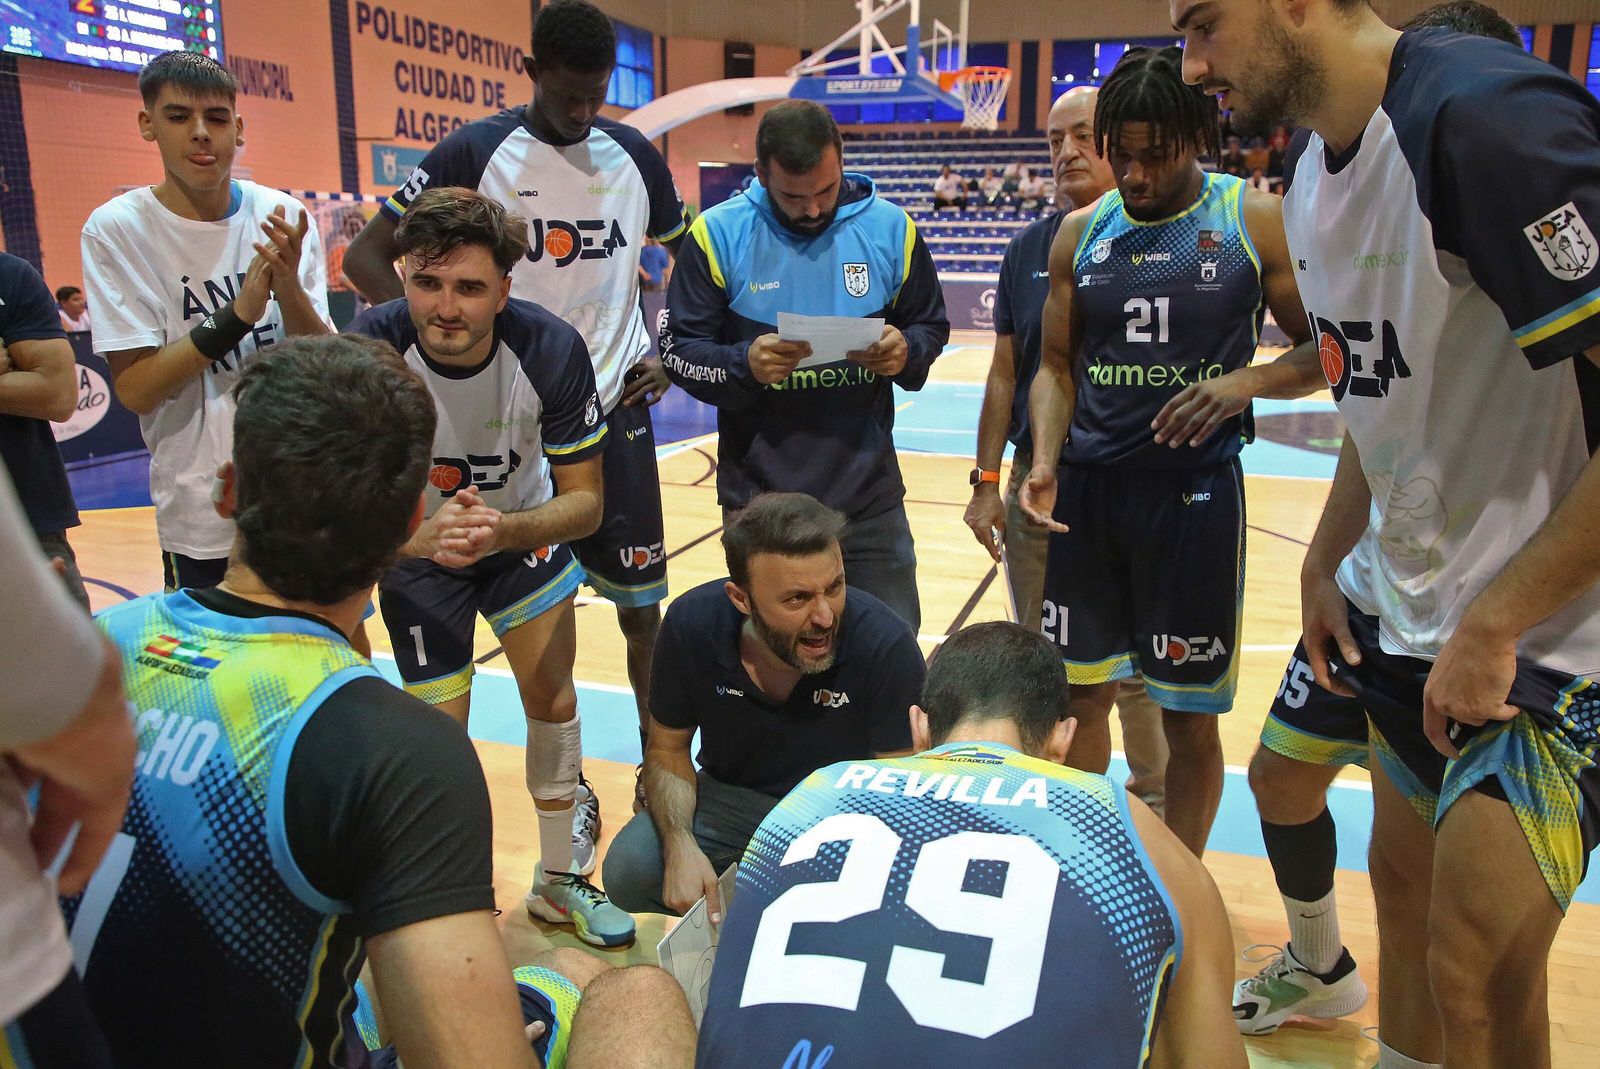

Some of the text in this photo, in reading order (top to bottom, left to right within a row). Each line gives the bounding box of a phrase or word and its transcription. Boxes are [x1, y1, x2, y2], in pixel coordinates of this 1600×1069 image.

[356, 1, 524, 75] POLIDEPORTIVO
[395, 60, 506, 109] CIUDAD DE
[395, 107, 469, 142] ALGE
[1145, 253, 1170, 261] WIBO
[759, 281, 780, 290] WIBO
[1124, 297, 1170, 342] 21
[763, 366, 875, 391] mex.io
[1041, 599, 1069, 646] 21
[409, 625, 427, 666] 1
[1153, 634, 1227, 665] UDEA
[813, 689, 850, 708] UDEA
[126, 701, 220, 786] CHO
[834, 763, 1049, 808] REVILLA
[740, 813, 1060, 1040] 29
